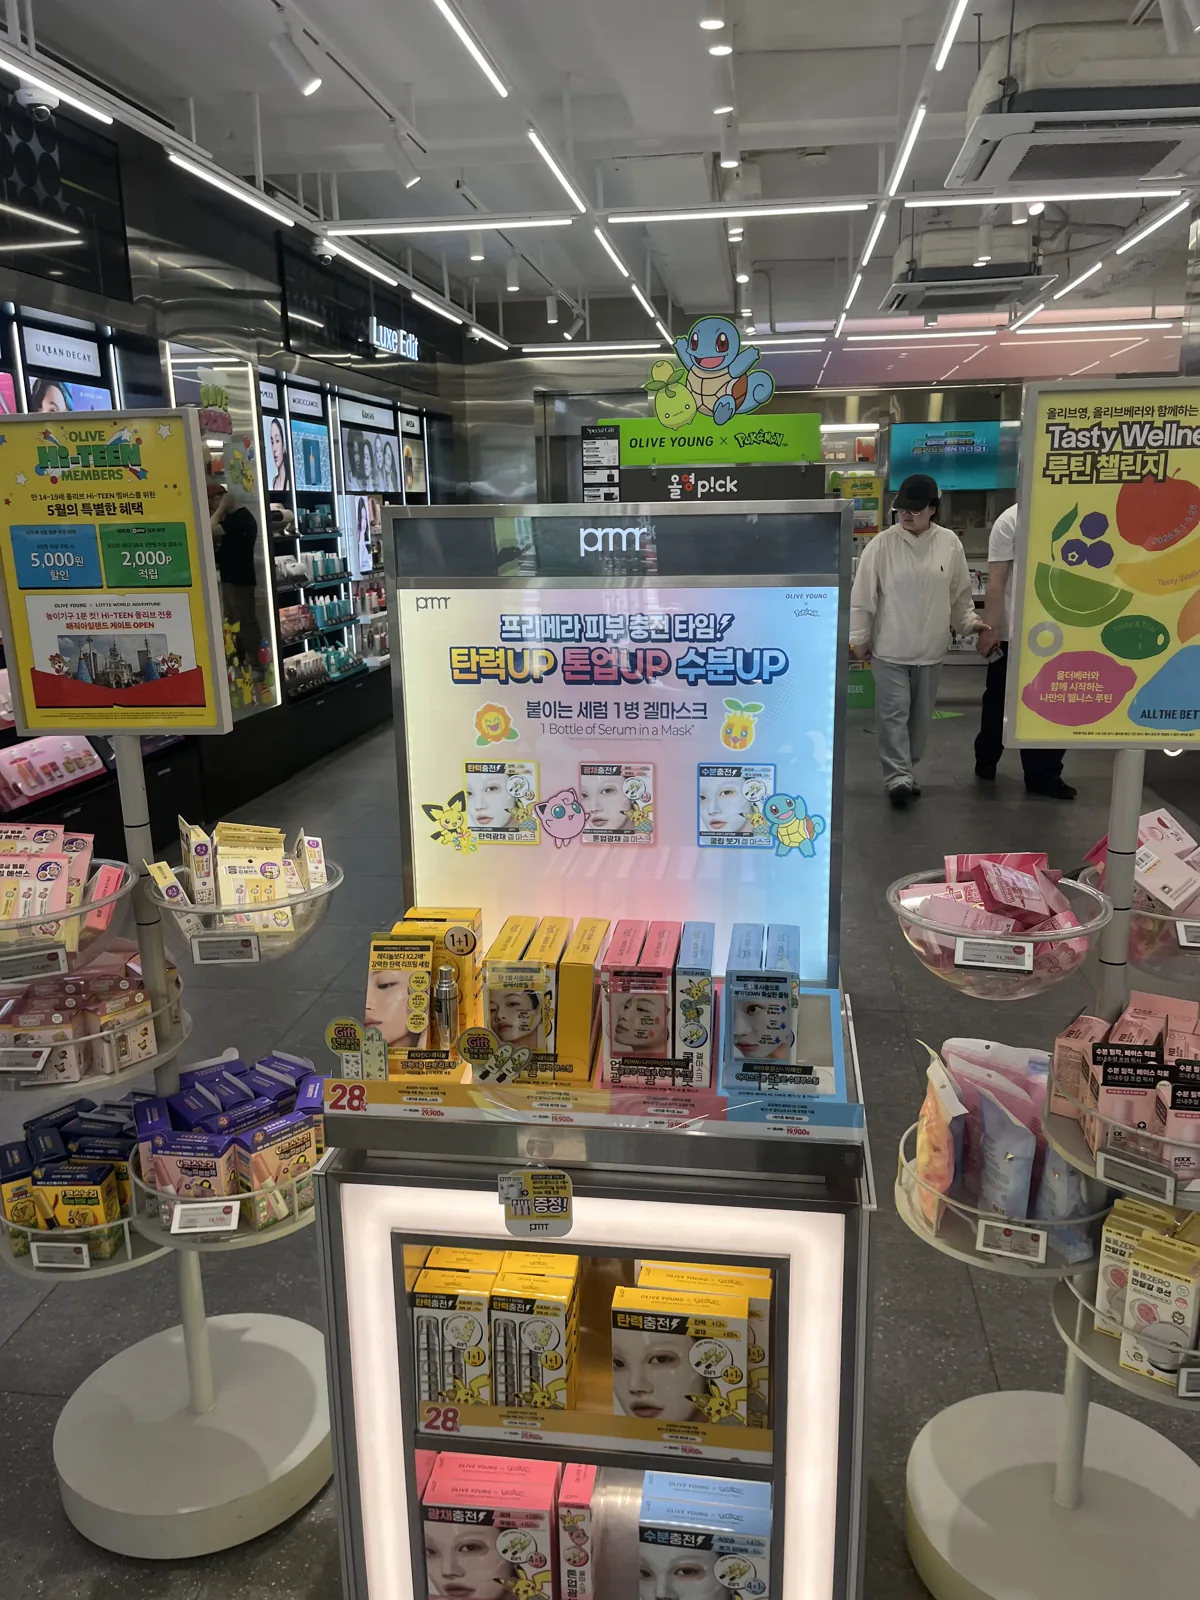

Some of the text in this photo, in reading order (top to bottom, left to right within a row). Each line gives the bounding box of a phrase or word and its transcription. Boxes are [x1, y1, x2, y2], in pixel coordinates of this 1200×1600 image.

[370, 317, 419, 361] Luxe Edit
[35, 343, 92, 363] URBAN DECAY
[1046, 405, 1199, 420] 올리브영, 올리브베러와 함께하는
[69, 431, 106, 442] OLIVE
[629, 437, 666, 449] OLIVE
[671, 436, 714, 447] YOUNG
[1046, 421, 1118, 453] Tasty
[37, 443, 141, 468] Hi-TEEN
[1043, 450, 1169, 484] 루틴 챌린지
[61, 469, 124, 481] MEMBERS
[116, 491, 141, 499] 멤버스를
[142, 490, 156, 499] 위한
[47, 501, 144, 517] 5월의 특별한 혜택
[31, 552, 85, 569] 5,000원
[121, 551, 173, 568] 2,000P
[50, 570, 70, 581] 할인
[139, 569, 158, 580] 적립
[1157, 577, 1178, 587] Tasty
[46, 611, 74, 620] 놀이기구
[89, 611, 99, 620] 컷!
[102, 610, 133, 619] Hi-TEEN
[135, 610, 156, 619] 올리브
[158, 610, 172, 619] 전용
[66, 621, 109, 630] 매직아일랜드
[110, 621, 132, 630] 게이트
[500, 614, 584, 642] 프리메라
[584, 614, 628, 642] 피부
[628, 613, 672, 643] 충전
[450, 646, 790, 686] 탄력UP 톤업UP 수분UP
[1050, 682, 1104, 692] 함께 시작하는
[1040, 693, 1113, 703] 나만의 웰니스 루틴
[526, 701, 573, 719] 붙이는
[577, 701, 608, 719] 세럼
[643, 702, 708, 720] 겔마스크
[1140, 709, 1177, 719] ALL THE
[549, 723, 583, 736] Bottle
[585, 723, 596, 735] of
[598, 724, 637, 736] Serum
[639, 724, 650, 736] in
[652, 727, 659, 736] a
[468, 764, 497, 773] 탄력충전
[584, 766, 613, 775] 광채충전
[702, 768, 732, 777] 수분충전
[478, 833, 506, 841] 탄력광채
[593, 835, 622, 843] 톤업광채
[630, 835, 652, 844] 마스크
[749, 838, 771, 846] 마스크
[450, 933, 469, 947] 1+1
[418, 961, 430, 969] 세럼
[334, 1026, 356, 1038] Gift
[467, 1036, 491, 1048] Gift
[1107, 1067, 1120, 1075] 수분
[1120, 1068, 1136, 1076] 밀착,
[1179, 1064, 1192, 1072] 수분
[1176, 1090, 1188, 1098] 수분
[534, 1196, 568, 1213] 증정!
[1131, 1278, 1154, 1291] 깐달걀
[617, 1314, 671, 1331] 탄력충전
[467, 1351, 481, 1361] 1+1
[428, 1509, 477, 1523] 광채충전
[644, 1530, 695, 1547] 수분충전
